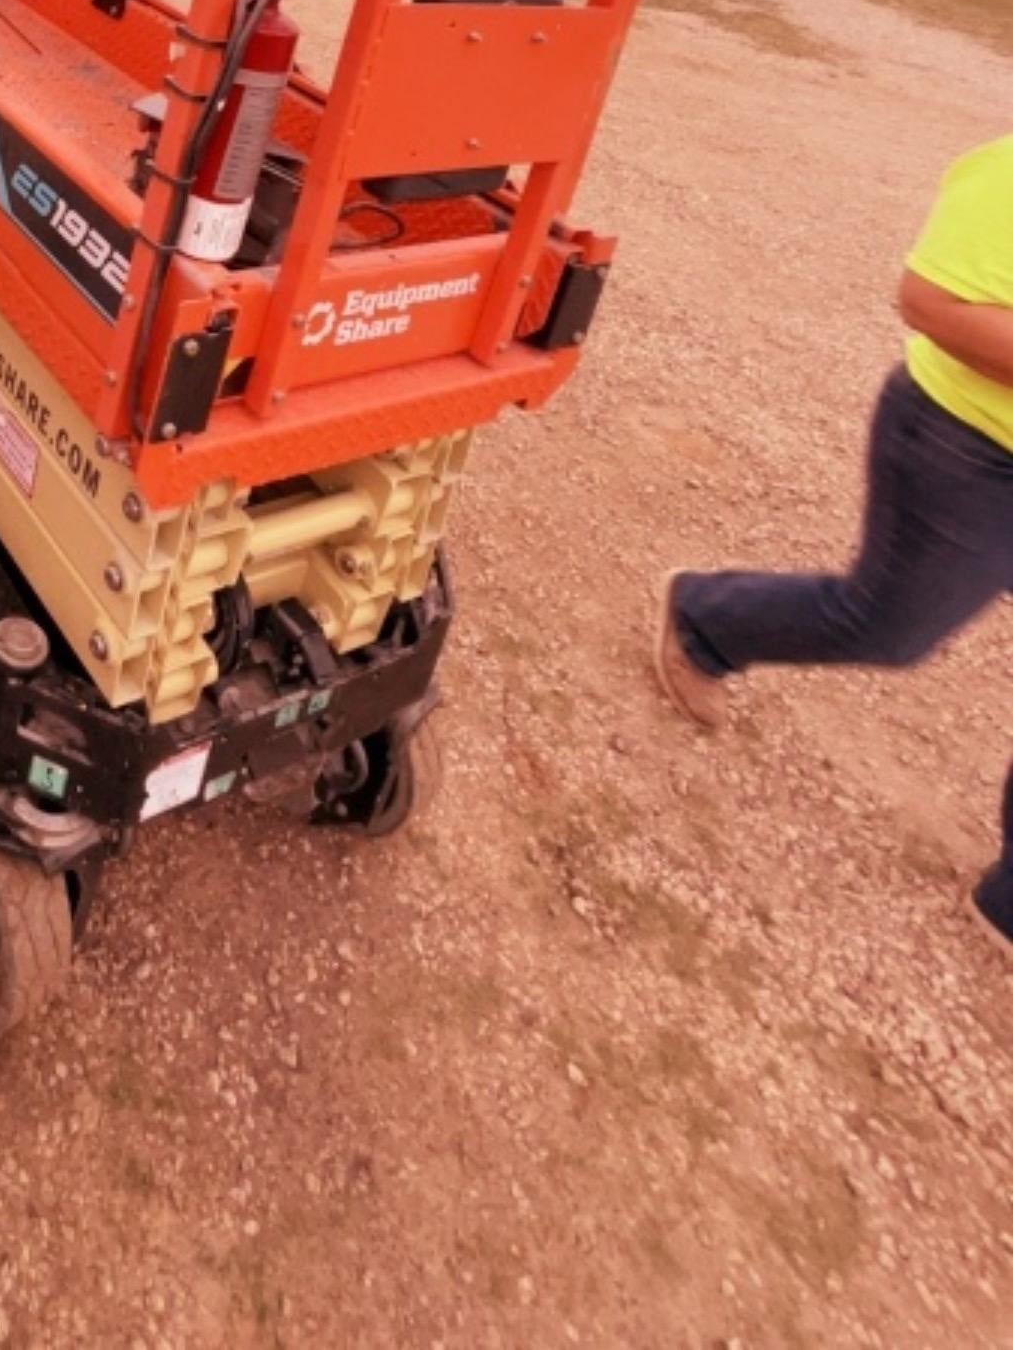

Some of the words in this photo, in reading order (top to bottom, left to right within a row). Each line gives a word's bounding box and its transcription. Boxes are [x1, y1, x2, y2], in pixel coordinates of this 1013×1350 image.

[10, 162, 131, 295] ES1932
[343, 271, 481, 318] Equipment
[334, 313, 412, 347] Share
